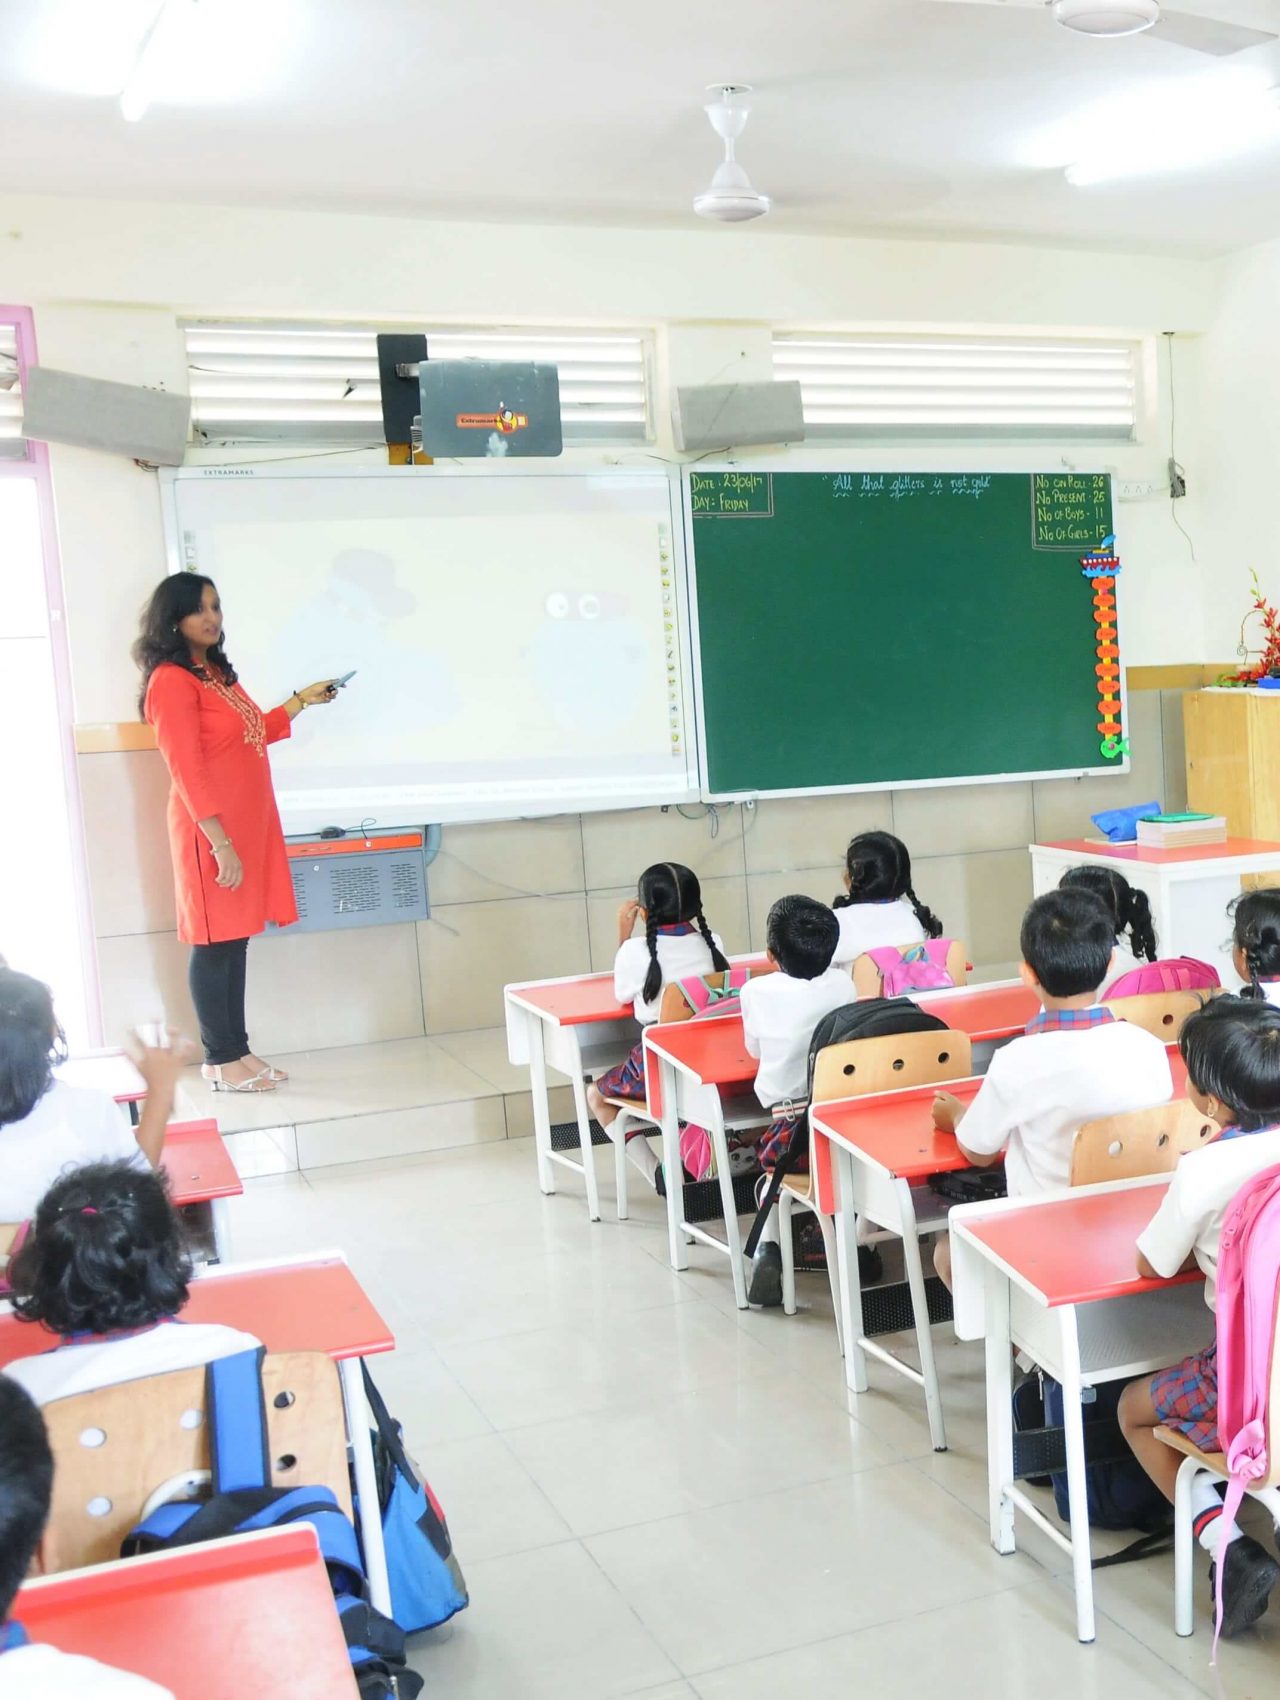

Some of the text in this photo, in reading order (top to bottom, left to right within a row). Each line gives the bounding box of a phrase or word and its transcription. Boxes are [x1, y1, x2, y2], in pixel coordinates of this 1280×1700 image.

[861, 474, 884, 490] that
[889, 474, 926, 499] glitters
[950, 475, 968, 488] not
[1092, 475, 1104, 488] 26
[720, 492, 749, 512] FRIDAY
[1052, 488, 1086, 504] PRESENT
[1095, 506, 1104, 519] 11
[1095, 524, 1108, 538] 15
